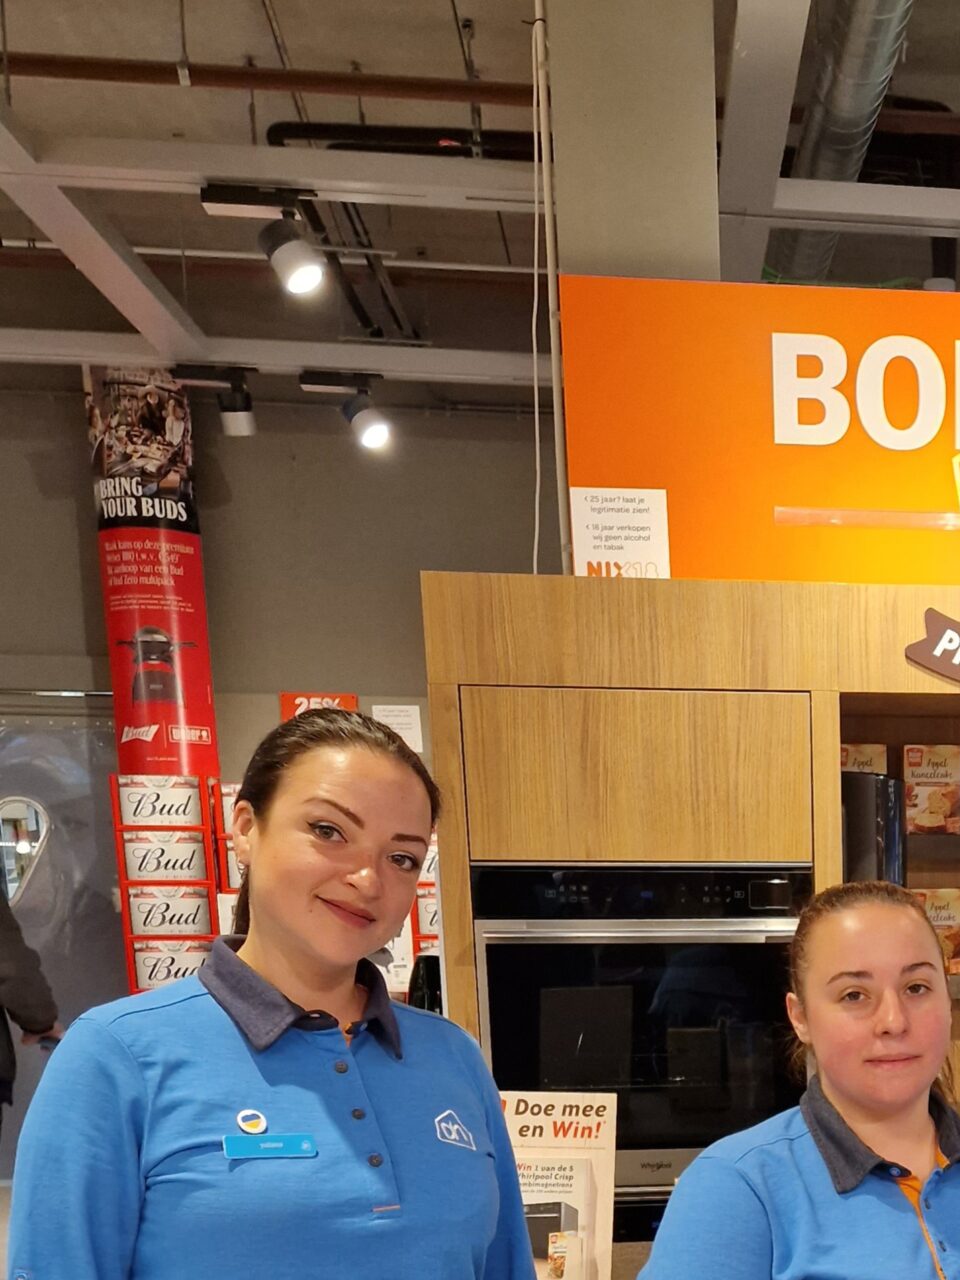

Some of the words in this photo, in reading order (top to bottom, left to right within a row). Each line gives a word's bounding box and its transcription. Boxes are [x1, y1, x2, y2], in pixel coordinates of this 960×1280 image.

[100, 477, 142, 498] BRING
[102, 497, 137, 519] YOUR
[141, 497, 187, 521] BUDS
[590, 506, 630, 514] legitimatie
[638, 497, 645, 505] je
[601, 524, 614, 532] jaar
[616, 524, 651, 532] verkopen
[127, 791, 192, 818] Bud
[132, 847, 194, 872] Bud
[137, 902, 200, 927] Bud
[514, 1098, 555, 1117] Doe
[561, 1104, 607, 1117] mee
[518, 1125, 543, 1138] en
[554, 1173, 574, 1182] Crisp
